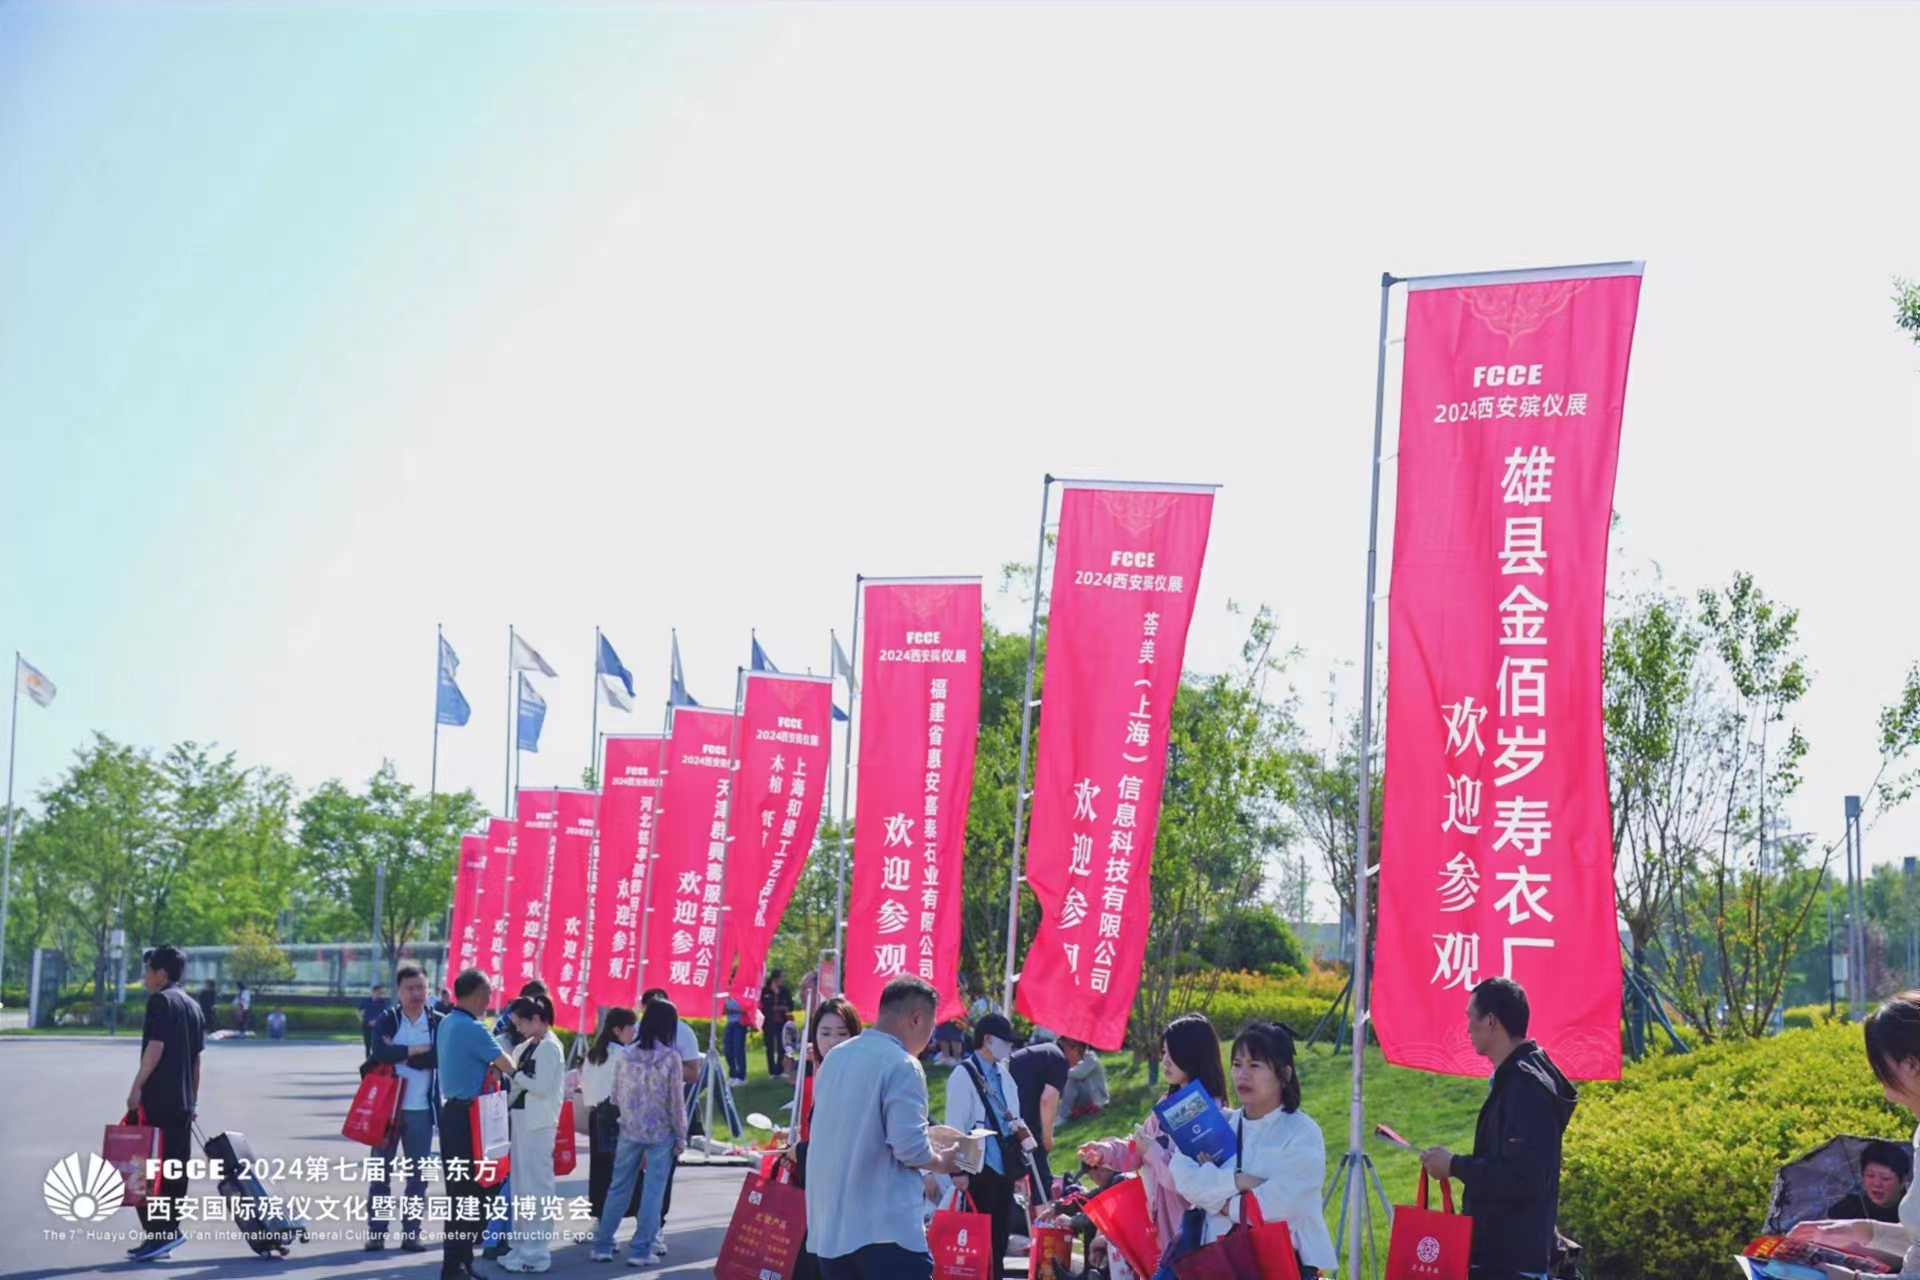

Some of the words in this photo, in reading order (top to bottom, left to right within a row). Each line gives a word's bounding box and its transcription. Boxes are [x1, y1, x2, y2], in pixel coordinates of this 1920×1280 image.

[1473, 364, 1543, 388] FCCE
[1433, 392, 1588, 424] 2024西安殡仪展
[1111, 550, 1155, 568] FCCE
[1075, 571, 1184, 593] 2024西安殡仪展
[906, 631, 941, 645] FCCE
[1492, 445, 1556, 980] 雄县金佰岁寿衣厂
[1430, 695, 1487, 992] 欢迎参观
[873, 812, 915, 977] 欢迎参观
[669, 870, 703, 986] 欢迎参观
